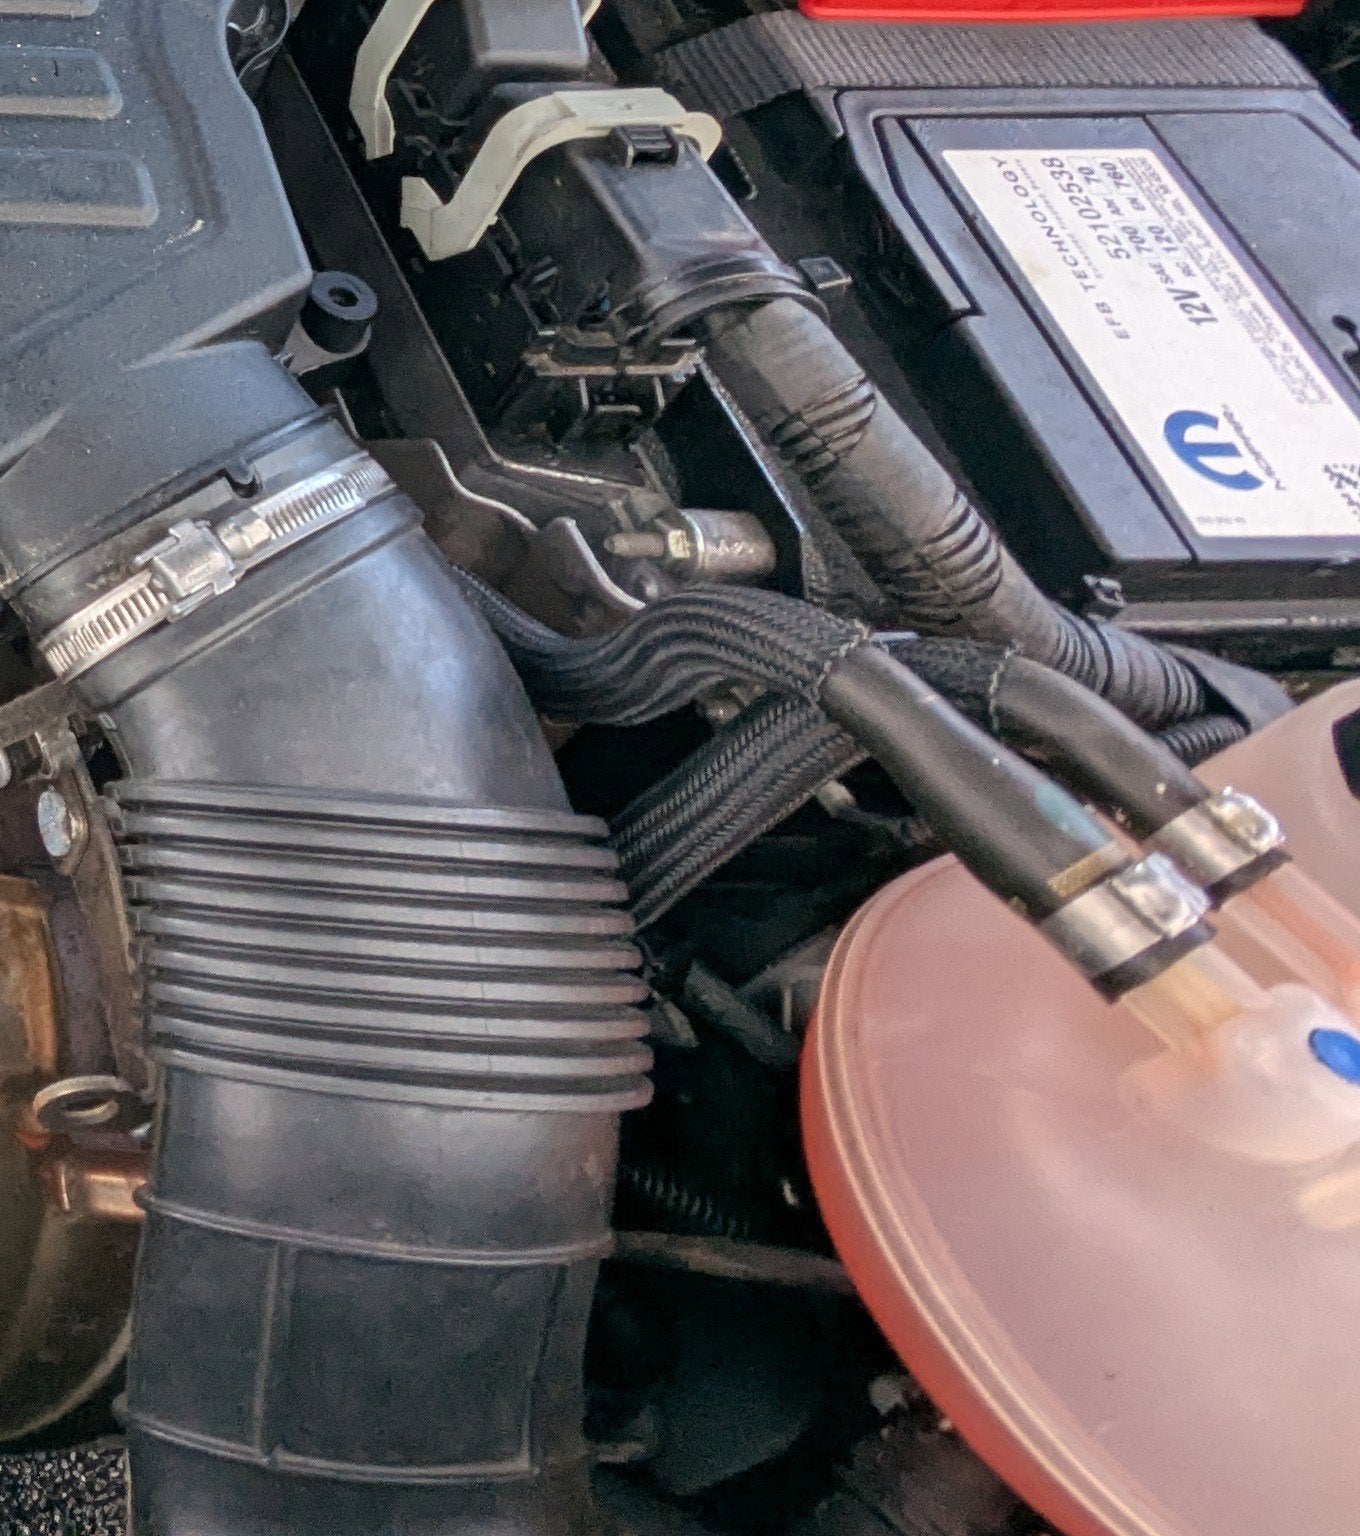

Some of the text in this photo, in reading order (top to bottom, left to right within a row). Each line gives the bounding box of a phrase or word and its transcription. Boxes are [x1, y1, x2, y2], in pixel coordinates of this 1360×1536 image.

[1074, 165, 1105, 185] 70
[1036, 156, 1134, 260] 52102538
[988, 156, 1133, 339] EFB TECHNOLOGY
[1118, 225, 1155, 253] 700
[1144, 224, 1182, 254] 120
[1162, 287, 1224, 326] 12V
